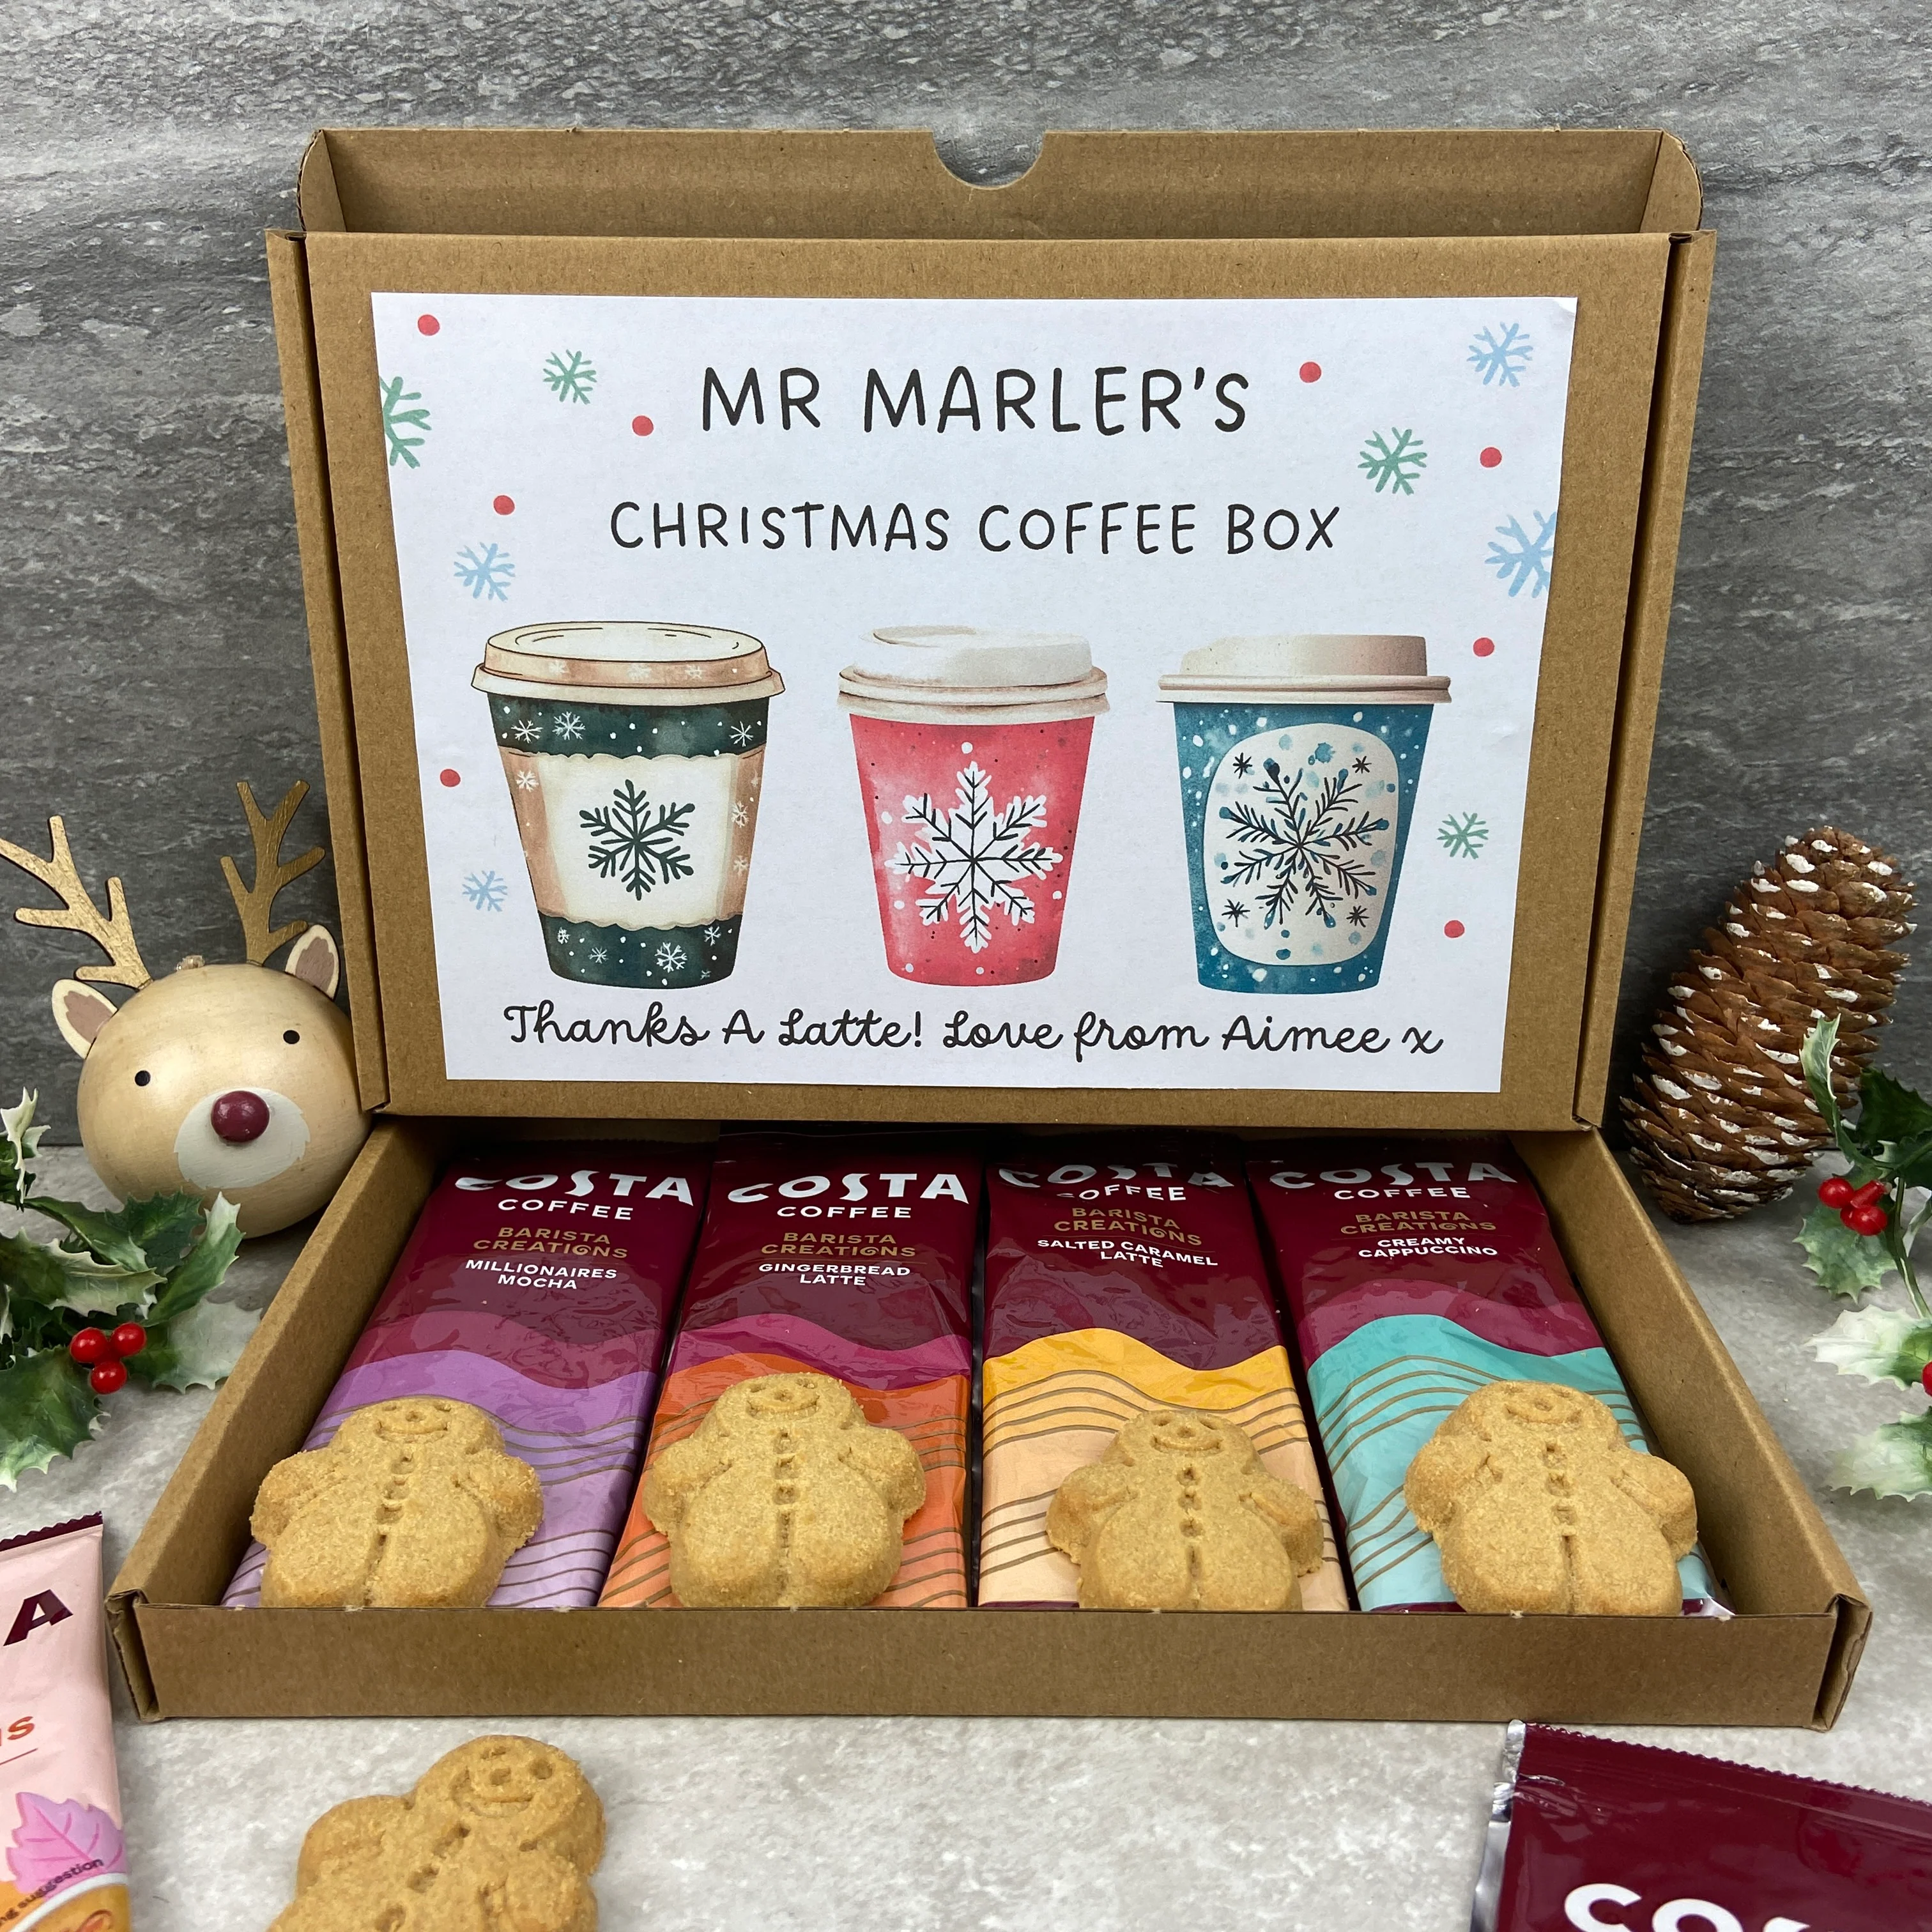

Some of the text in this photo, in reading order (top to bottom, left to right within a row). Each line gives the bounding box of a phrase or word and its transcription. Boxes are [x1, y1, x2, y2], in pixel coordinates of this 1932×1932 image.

[703, 365, 1249, 436] MR MARLER'S
[611, 502, 1340, 555] CHRISTMAS COFFEE BOX
[503, 999, 1444, 1063] Thanks A Latte! Love from Aimee x
[998, 1163, 1234, 1188] COSTA
[1270, 1162, 1518, 1189] COSTA
[455, 1170, 694, 1207] COSTA
[728, 1173, 969, 1204] COSTA
[1057, 1184, 1186, 1201] COFFEE
[1334, 1187, 1471, 1200] COFFEE
[498, 1199, 633, 1220] COFFEE
[777, 1206, 912, 1218] COFFEE
[1356, 1211, 1470, 1223] BARISTA
[1072, 1208, 1180, 1229] BARISTA
[497, 1227, 610, 1244] BARISTA
[1054, 1220, 1202, 1245] CREATIONS
[1340, 1222, 1496, 1234] CREATIONS
[784, 1232, 896, 1244] BARISTA
[1377, 1237, 1465, 1247] CREAMY
[473, 1239, 628, 1258] CREATIONS
[761, 1244, 916, 1257] CREATIONS
[1038, 1239, 1218, 1266] SALTED CARAMEL
[1358, 1245, 1498, 1257] CAPPUCCINO
[1100, 1251, 1164, 1268] LATTE
[465, 1259, 617, 1278] MILLIONAIRES
[758, 1263, 910, 1276] GINGERBREAD
[498, 1275, 578, 1289] MOCHA
[800, 1274, 866, 1285] LATTE
